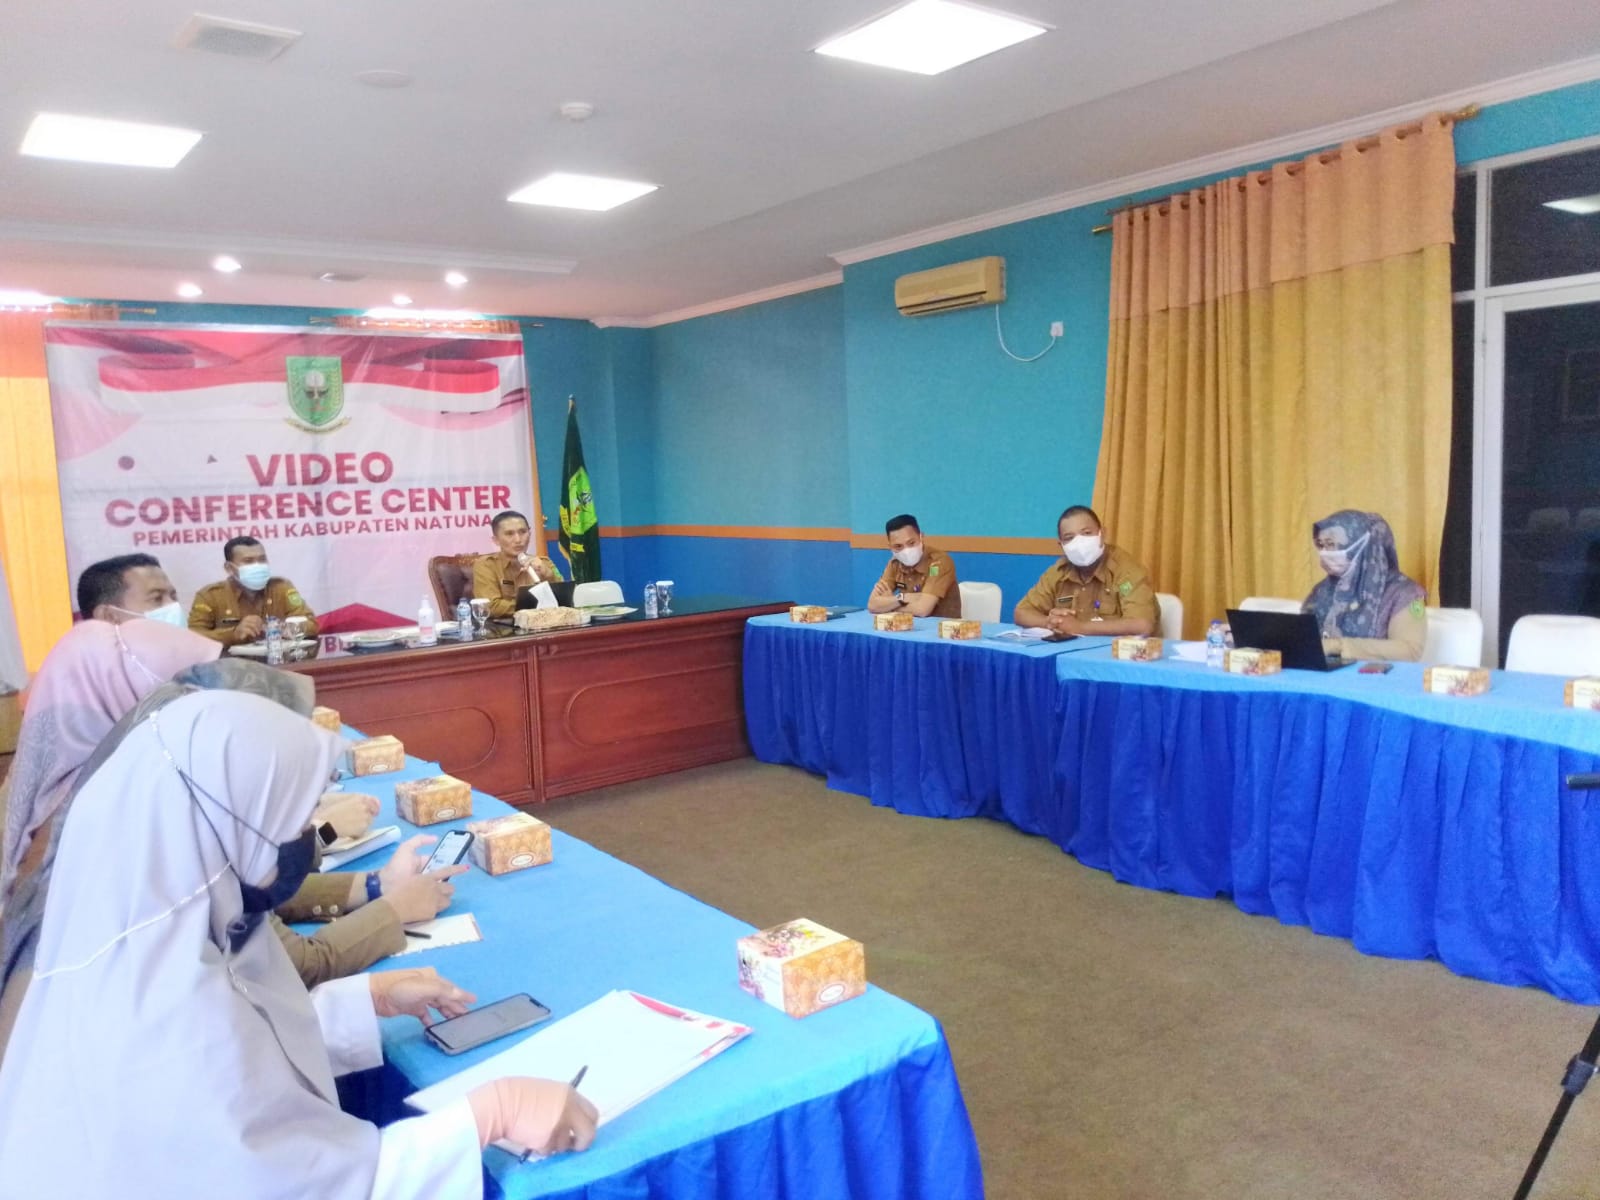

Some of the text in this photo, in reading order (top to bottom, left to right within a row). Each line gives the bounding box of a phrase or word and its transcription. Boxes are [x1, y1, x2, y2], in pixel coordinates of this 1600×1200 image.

[246, 452, 393, 487] VIDEO
[105, 485, 511, 528] CONFERENCE CENTER
[133, 514, 492, 546] PEMERINTAH KABUPATEN NATUNA
